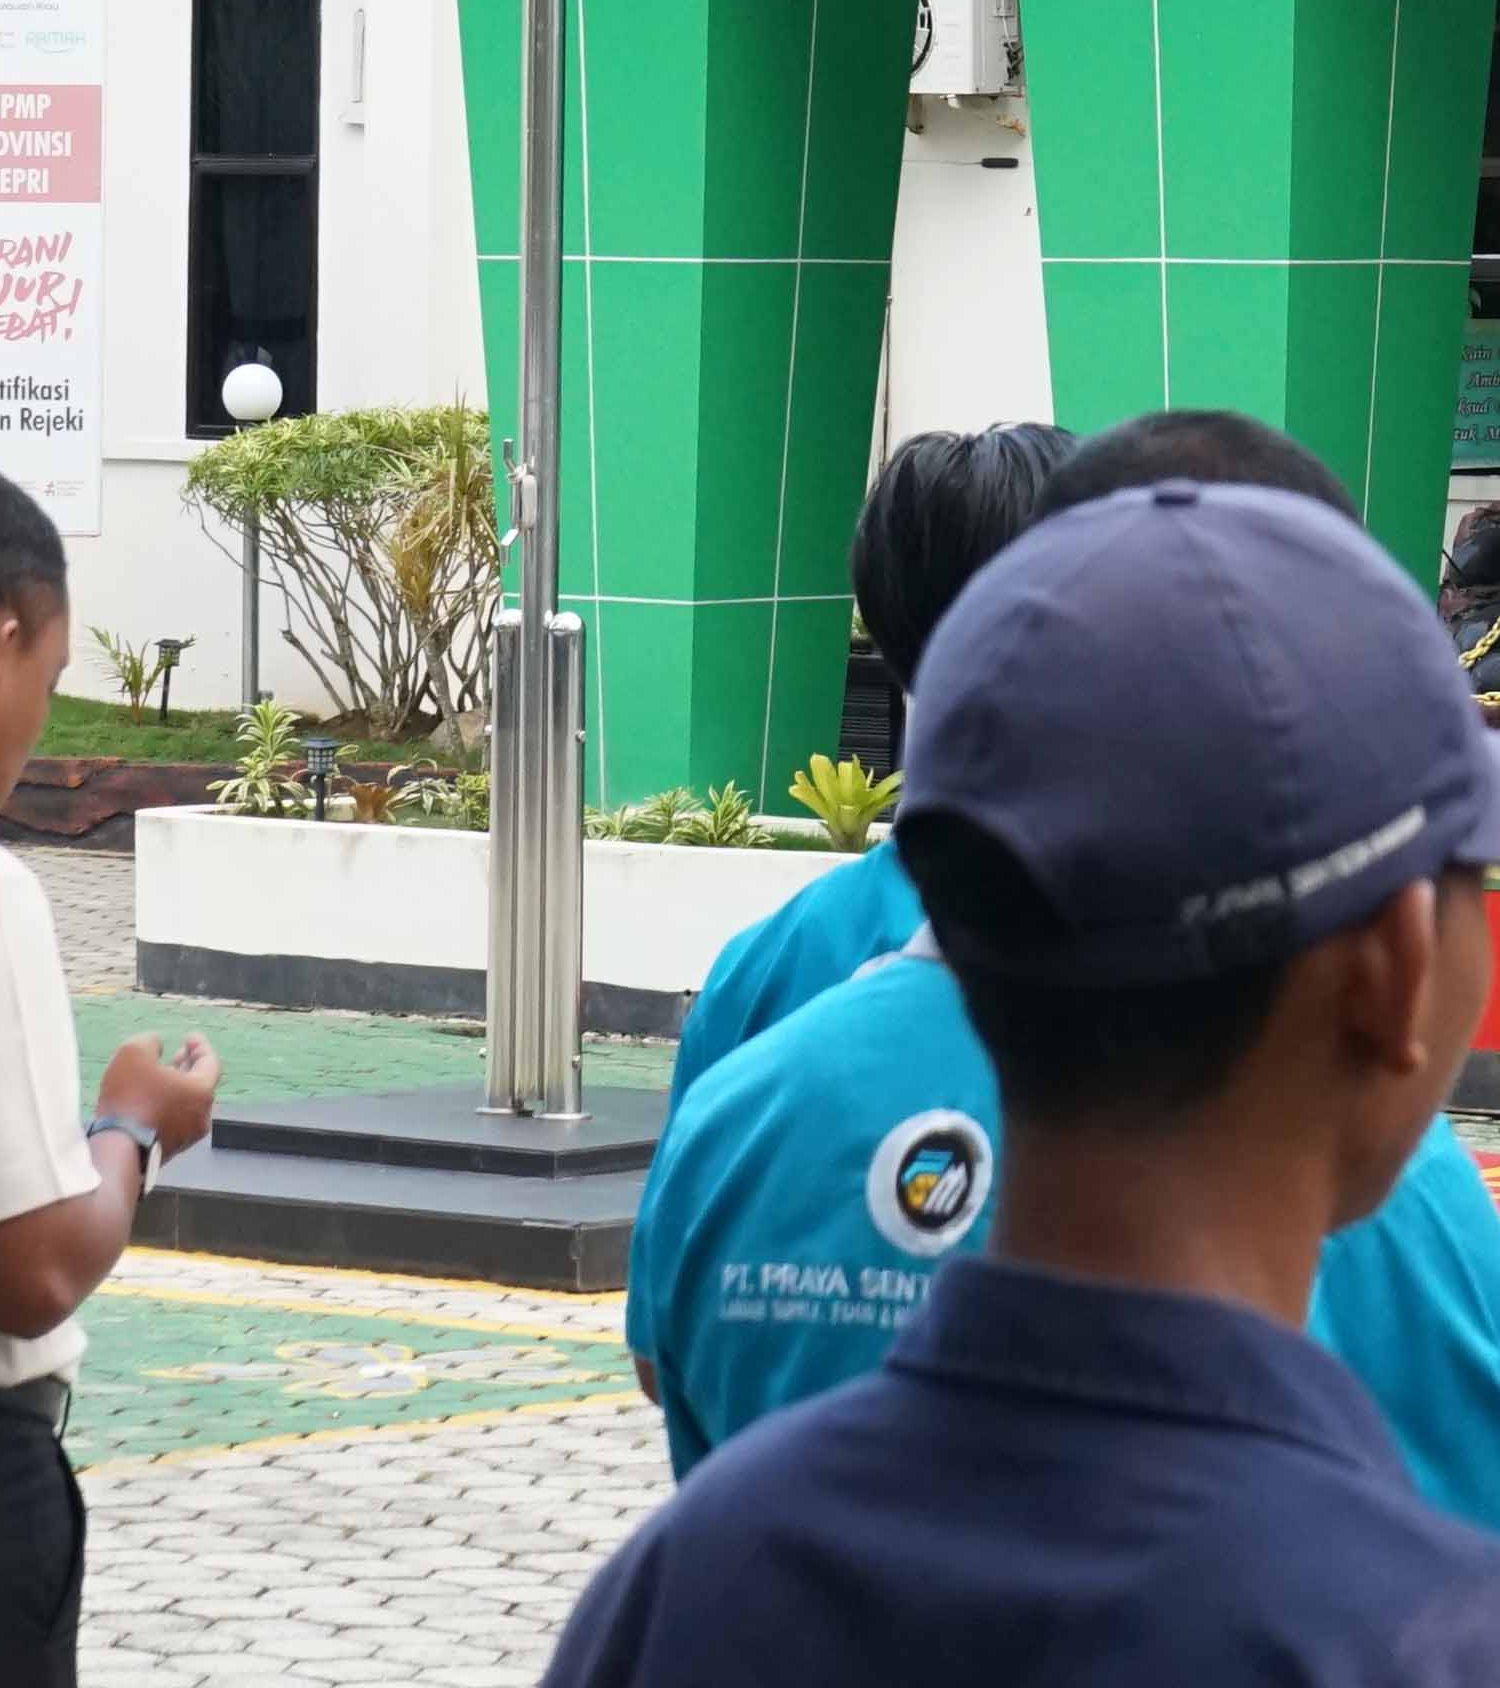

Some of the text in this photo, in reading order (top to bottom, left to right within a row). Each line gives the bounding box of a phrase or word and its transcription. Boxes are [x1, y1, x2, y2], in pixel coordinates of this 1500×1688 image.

[20, 407, 84, 436] Rejeki
[760, 1262, 849, 1298] PRAYA
[860, 1266, 932, 1302] SENT
